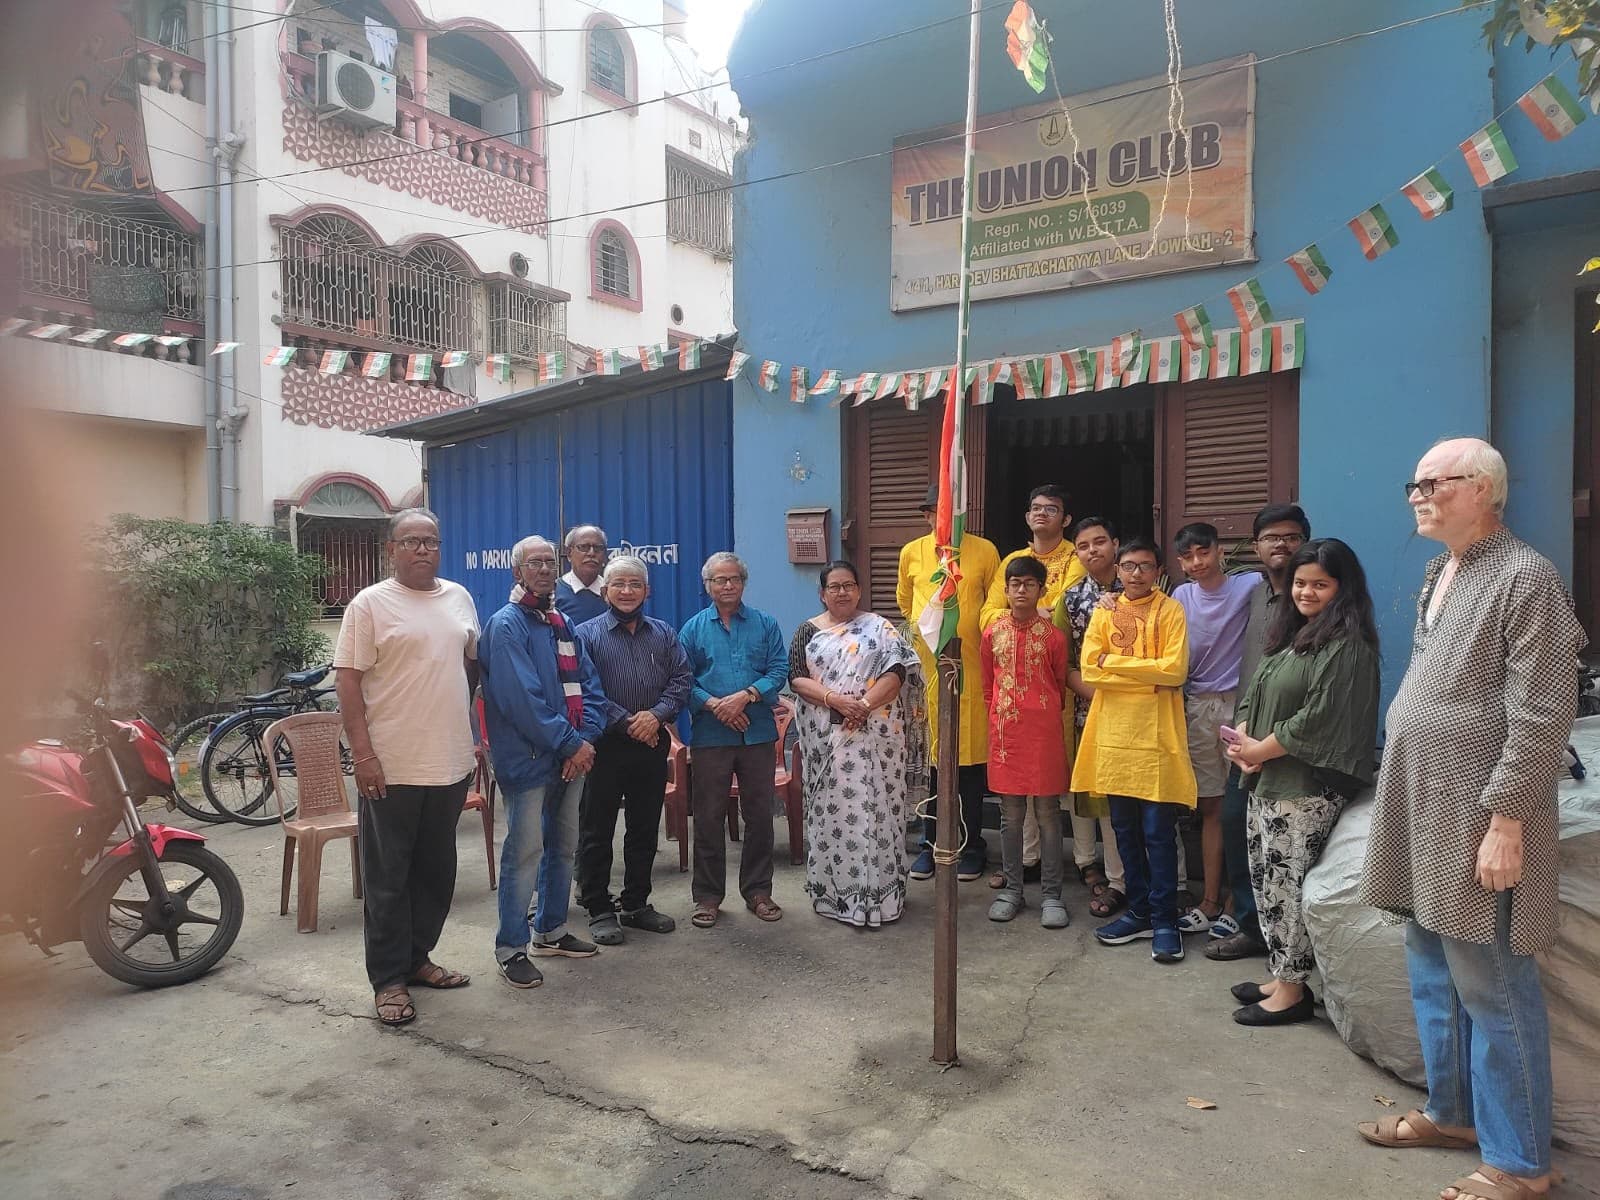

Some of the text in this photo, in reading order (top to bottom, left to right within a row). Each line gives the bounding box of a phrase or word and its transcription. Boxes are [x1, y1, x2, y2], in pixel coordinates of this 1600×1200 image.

[904, 122, 1222, 226] THE UNION CLUB
[985, 222, 1023, 238] Regn.
[1028, 213, 1054, 229] NO.
[1068, 199, 1127, 223] S/16039
[970, 236, 1030, 257] Affiliated
[1034, 231, 1064, 248] with
[992, 249, 1101, 283] BHATTACHARYYA
[1223, 229, 1234, 246] 2
[466, 549, 512, 570] NO PARKI
